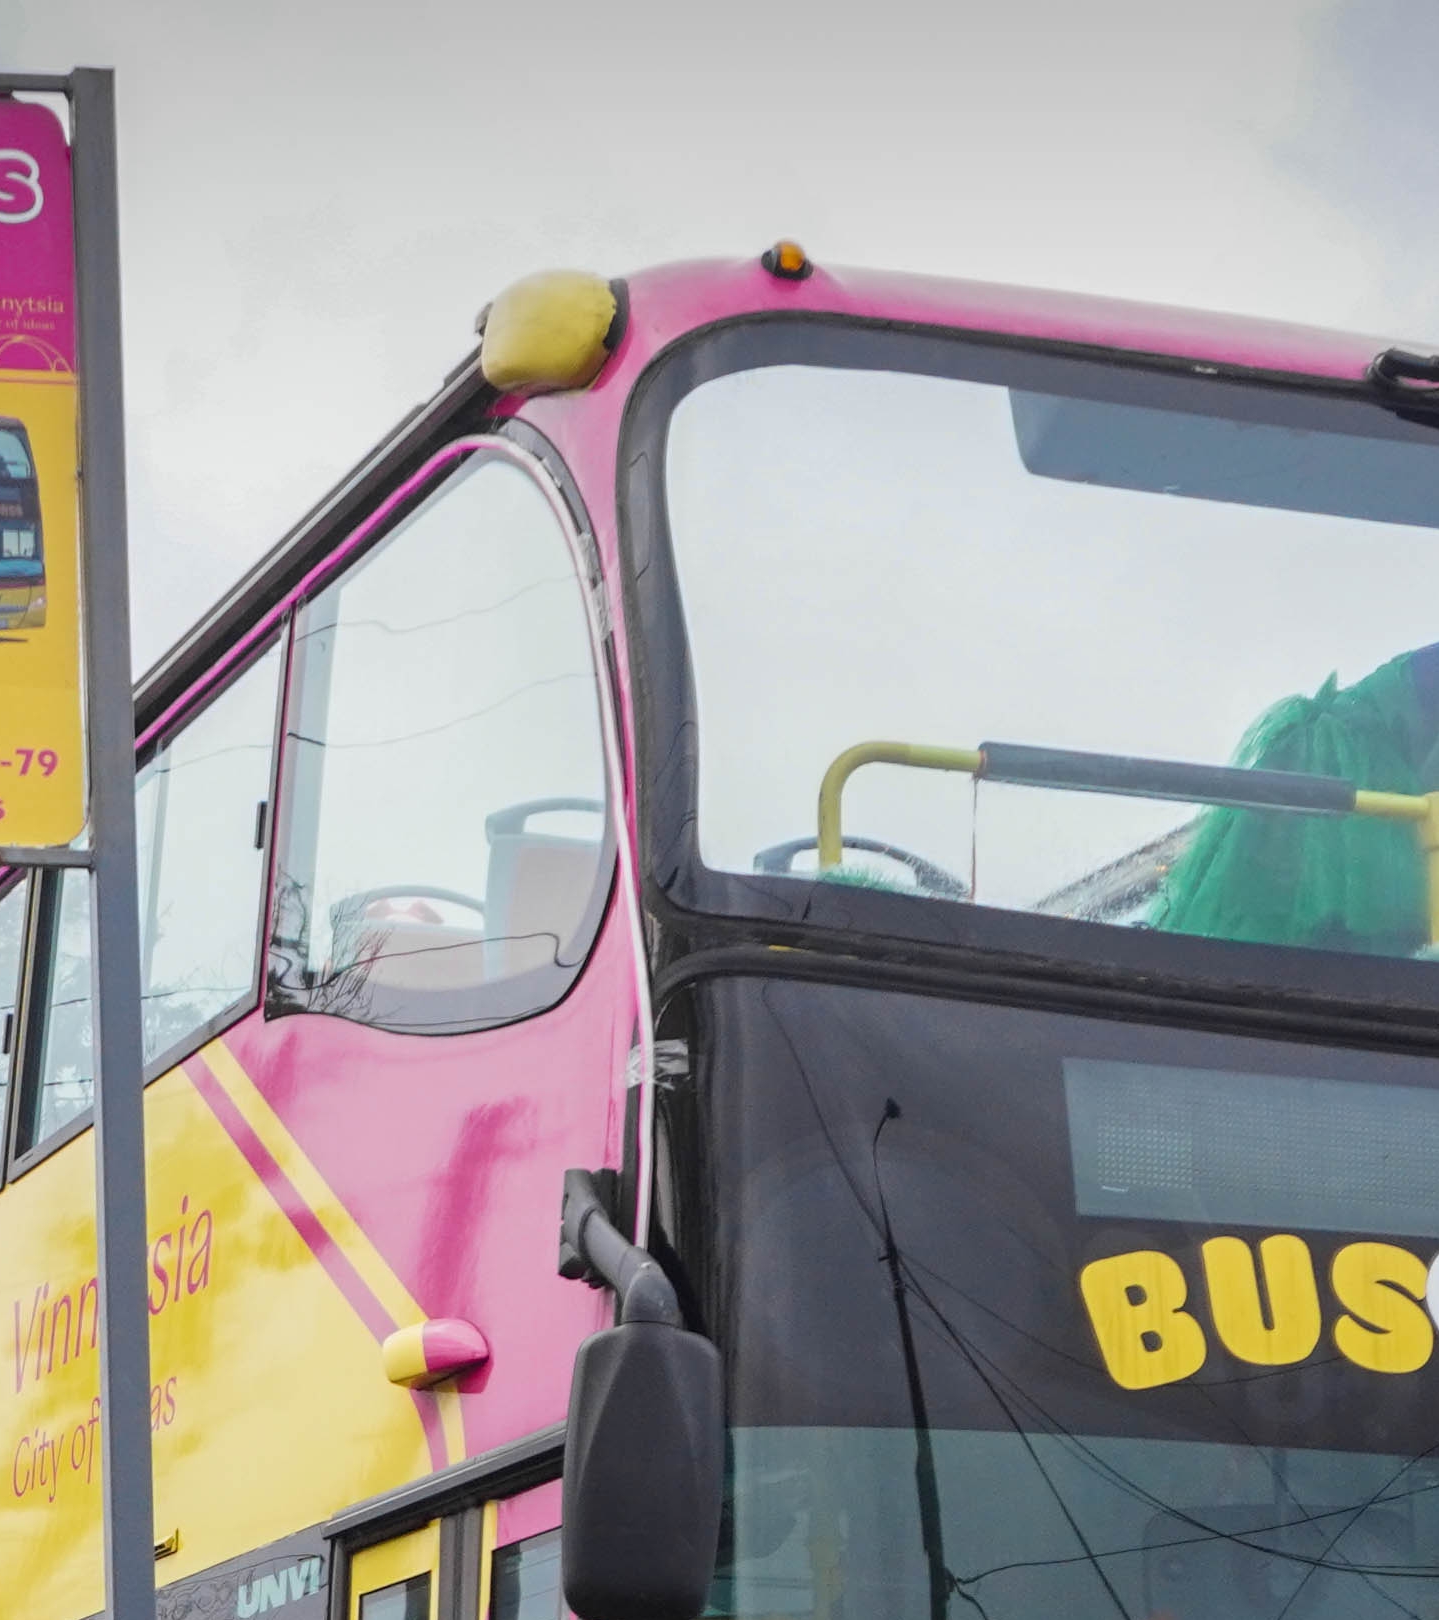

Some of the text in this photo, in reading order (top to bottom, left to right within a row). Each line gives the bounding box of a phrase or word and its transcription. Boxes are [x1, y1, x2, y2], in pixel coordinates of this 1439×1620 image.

[14, 1194, 213, 1394] Vinnsia
[1079, 1233, 1435, 1391] BUS
[13, 1428, 64, 1503] City
[71, 1396, 101, 1484] of
